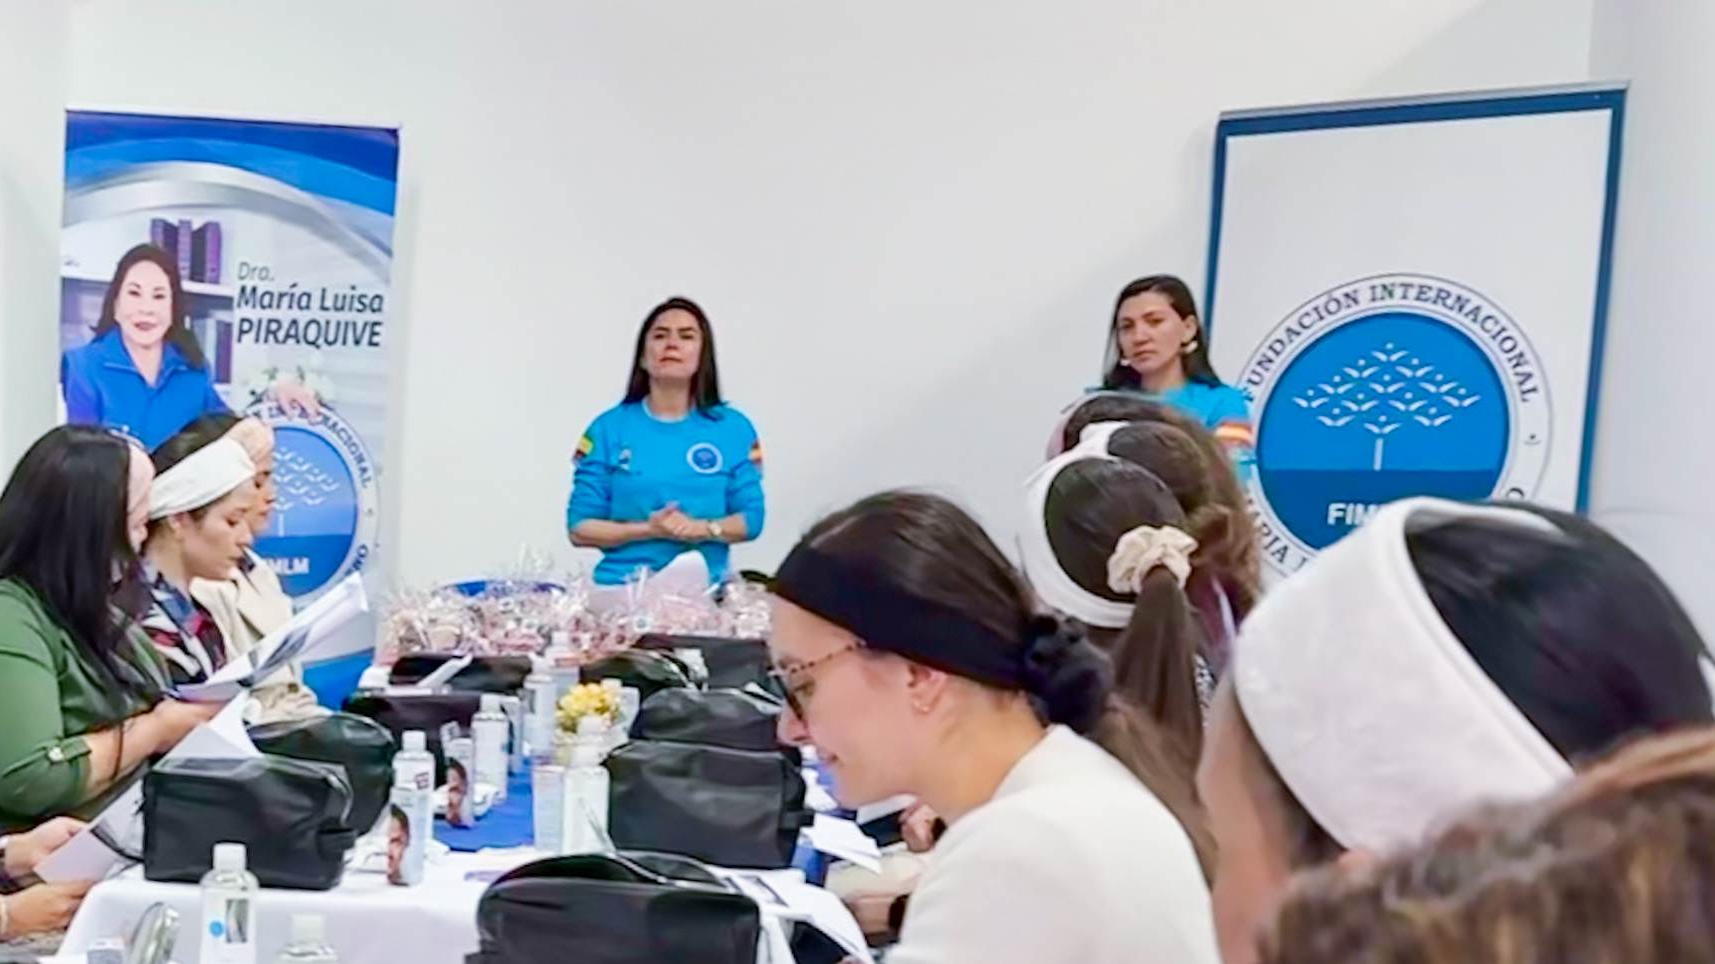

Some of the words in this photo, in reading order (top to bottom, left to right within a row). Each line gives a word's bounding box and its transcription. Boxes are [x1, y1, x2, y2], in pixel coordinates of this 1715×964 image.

[238, 261, 276, 281] Dra.
[236, 282, 312, 310] María
[318, 285, 384, 313] Luisa
[236, 317, 383, 350] PIRAQUIVE
[1369, 282, 1540, 402] INTERNACIONAL
